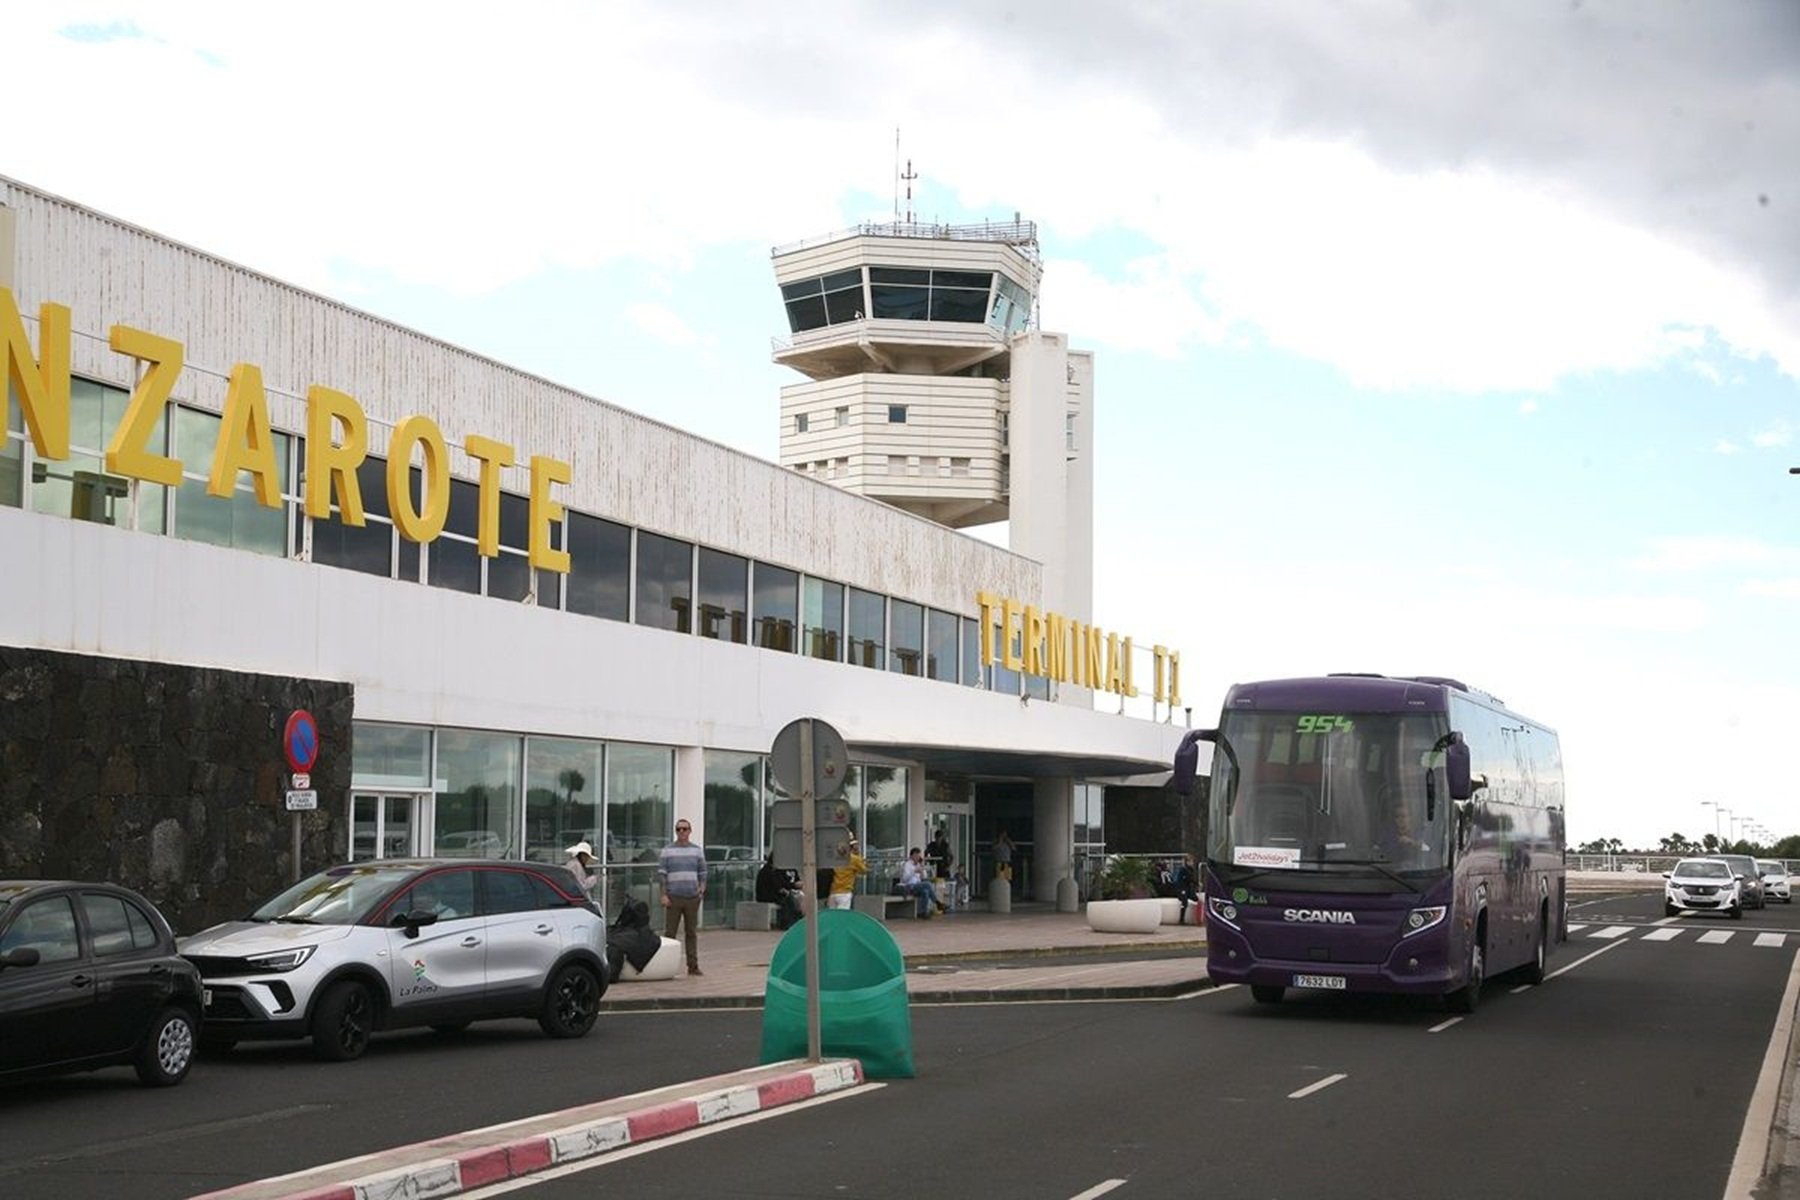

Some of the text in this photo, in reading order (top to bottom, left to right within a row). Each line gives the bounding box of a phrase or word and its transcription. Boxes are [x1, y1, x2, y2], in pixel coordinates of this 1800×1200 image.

[976, 591, 1182, 706] TERMINAL T1
[1296, 715, 1353, 733] 954
[1283, 908, 1356, 925] SCANIA
[1299, 975, 1324, 987] 7632
